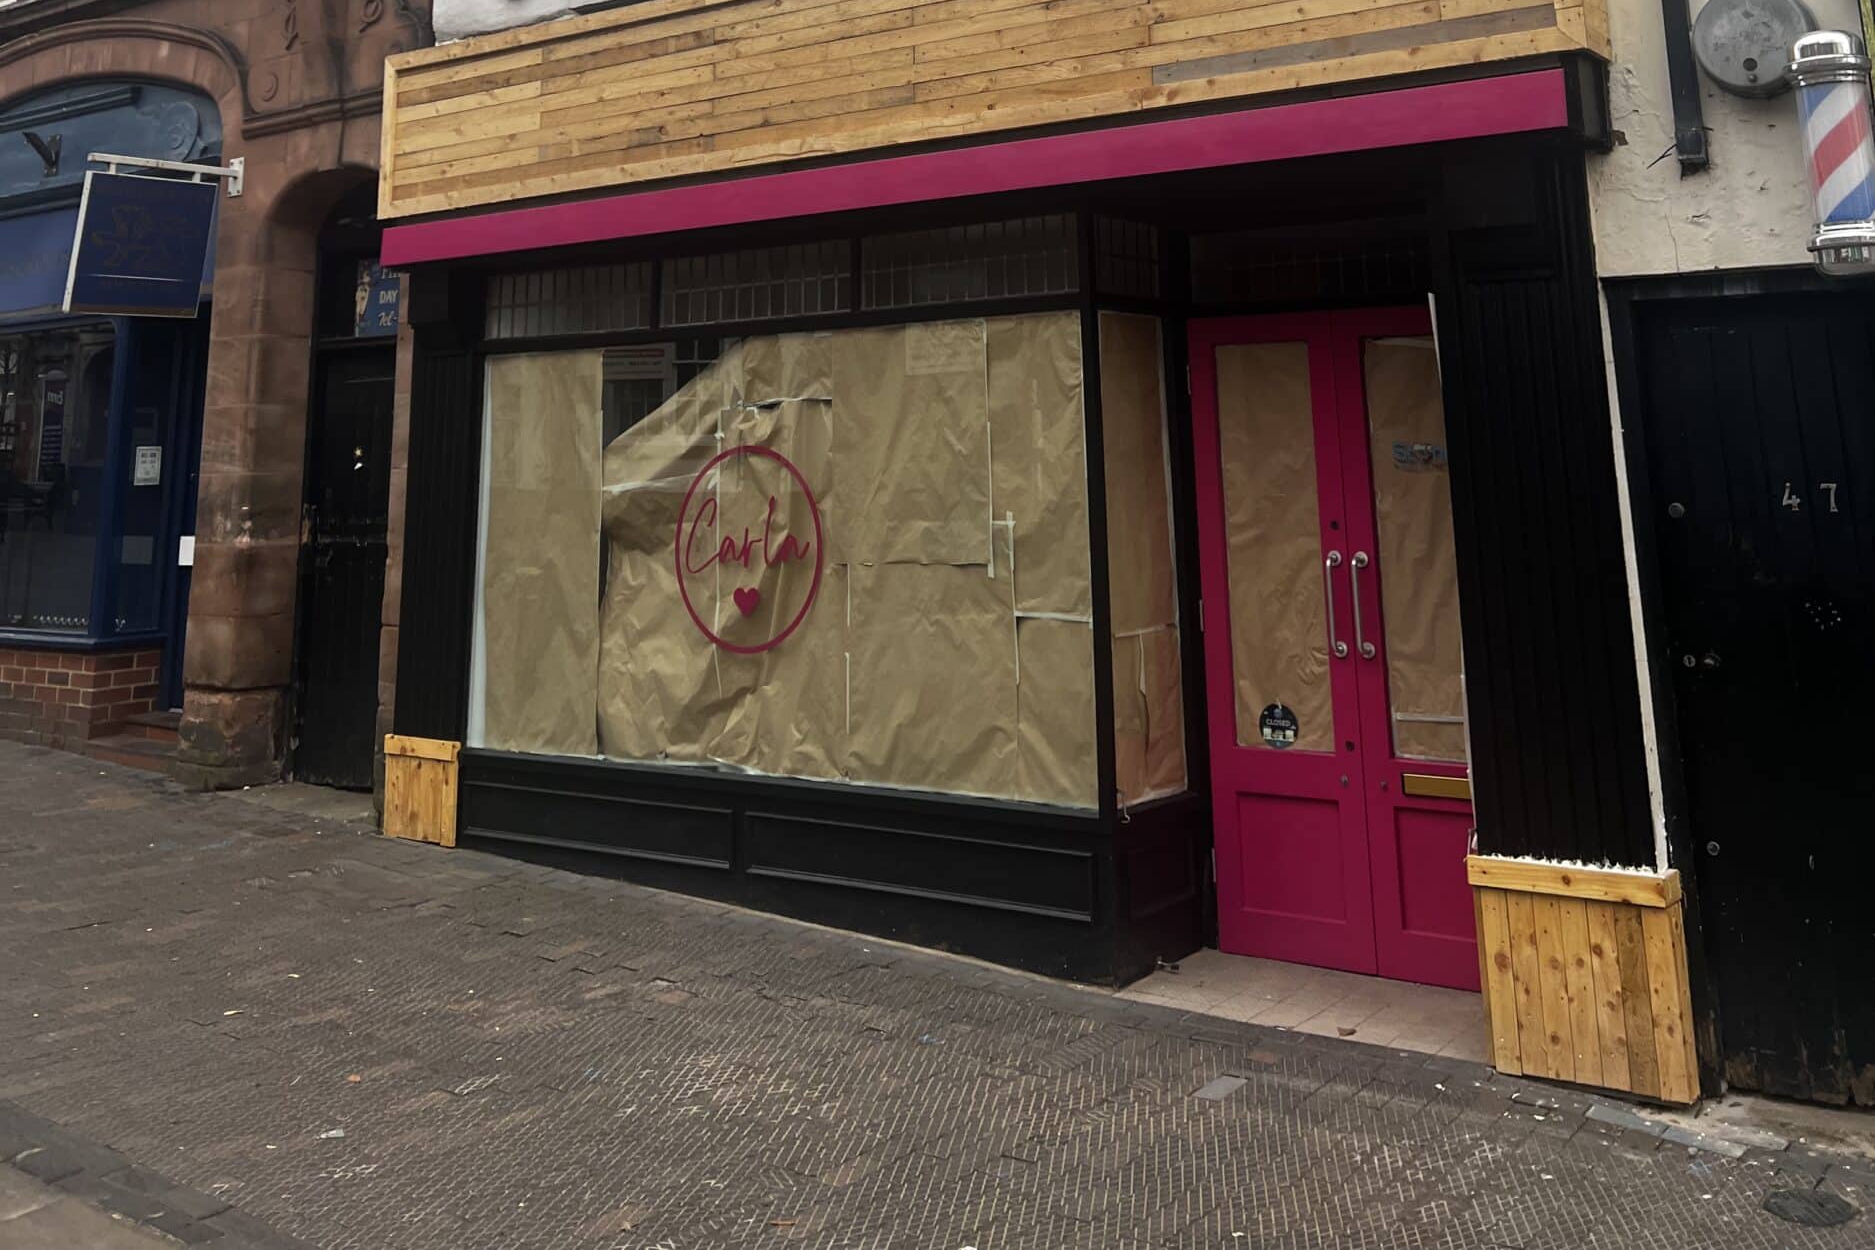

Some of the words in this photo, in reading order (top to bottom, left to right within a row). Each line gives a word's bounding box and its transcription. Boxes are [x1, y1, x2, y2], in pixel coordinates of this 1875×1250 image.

[379, 290, 399, 304] DAY
[686, 495, 811, 574] Carla
[1265, 718, 1291, 728] CLOSED
